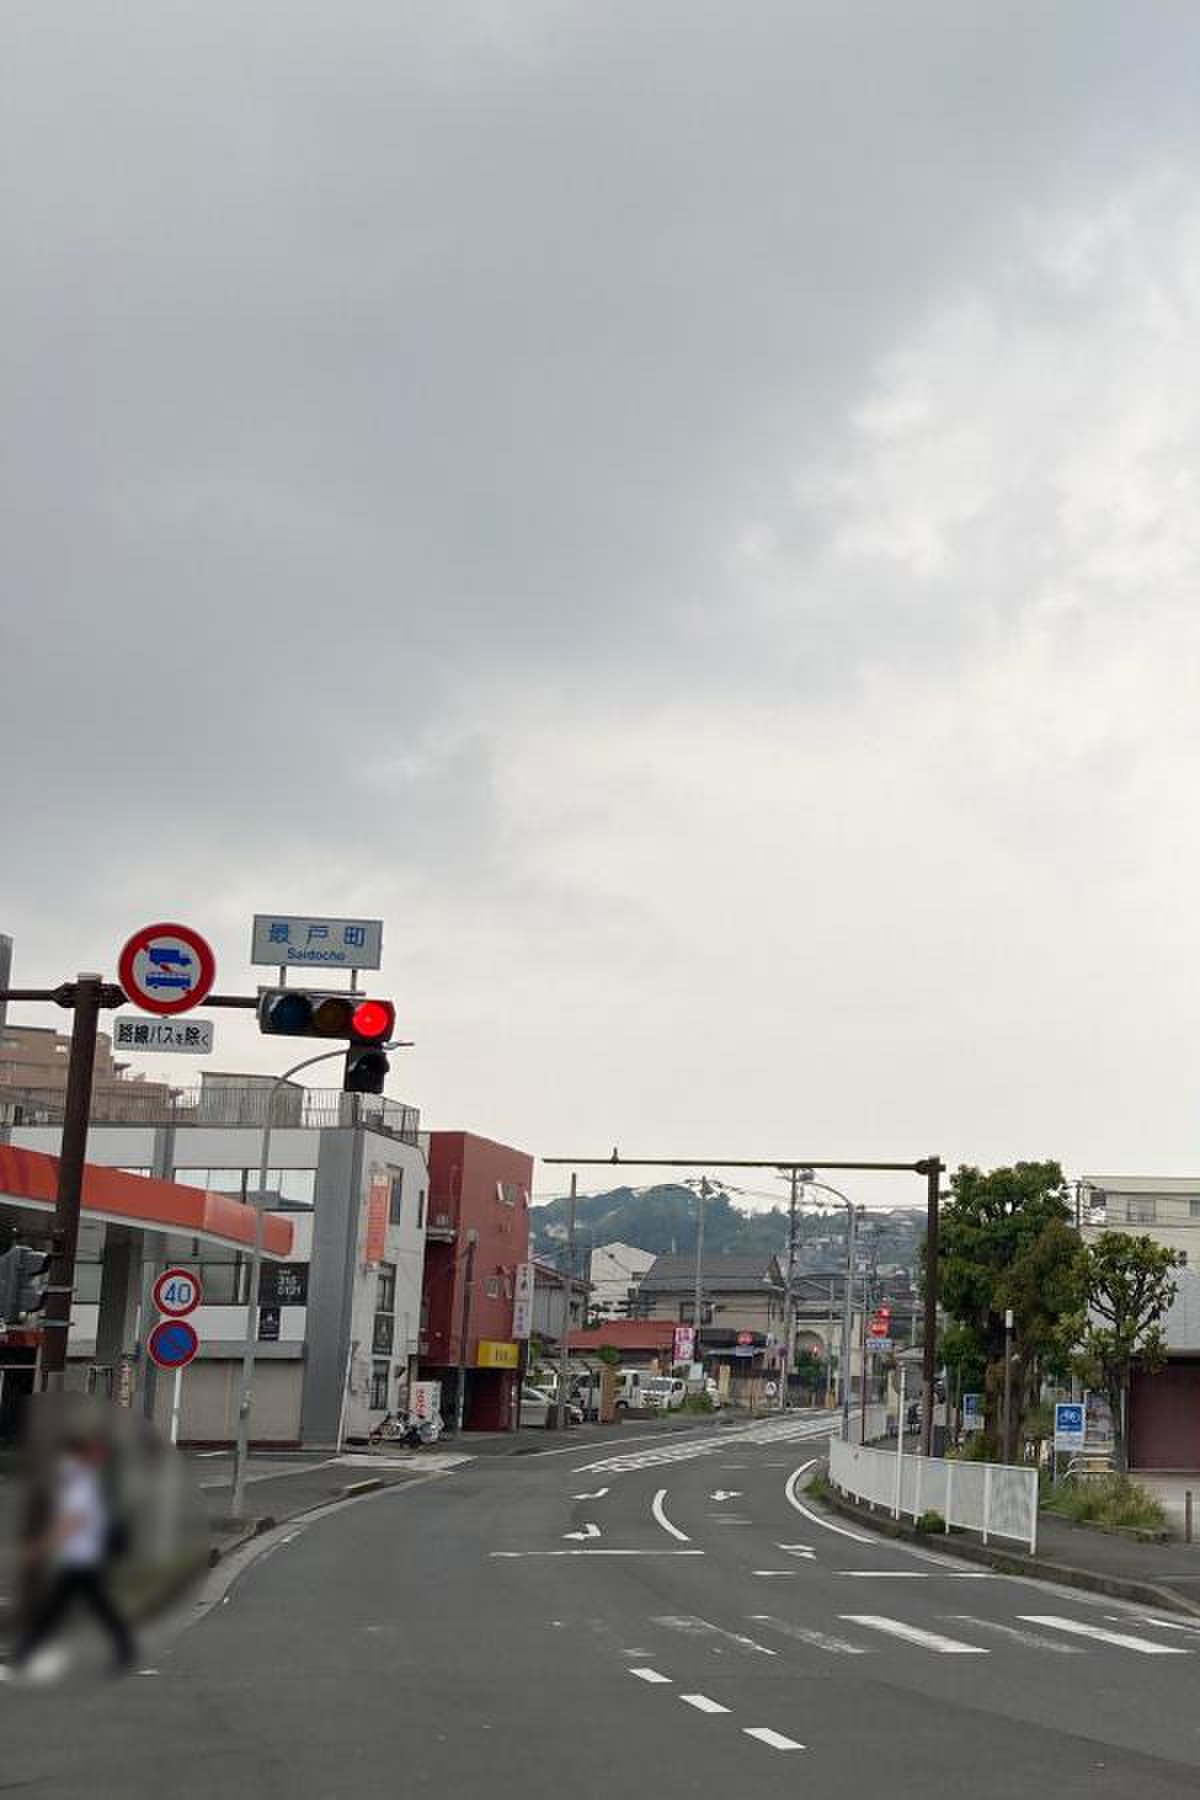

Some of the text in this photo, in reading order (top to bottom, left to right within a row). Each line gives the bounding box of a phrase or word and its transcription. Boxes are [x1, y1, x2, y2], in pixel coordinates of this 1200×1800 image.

[269, 923, 365, 947] 最戸町
[288, 947, 345, 960] Saidocho
[118, 1023, 209, 1048] 路線バスを除く
[165, 1283, 191, 1304] 40
